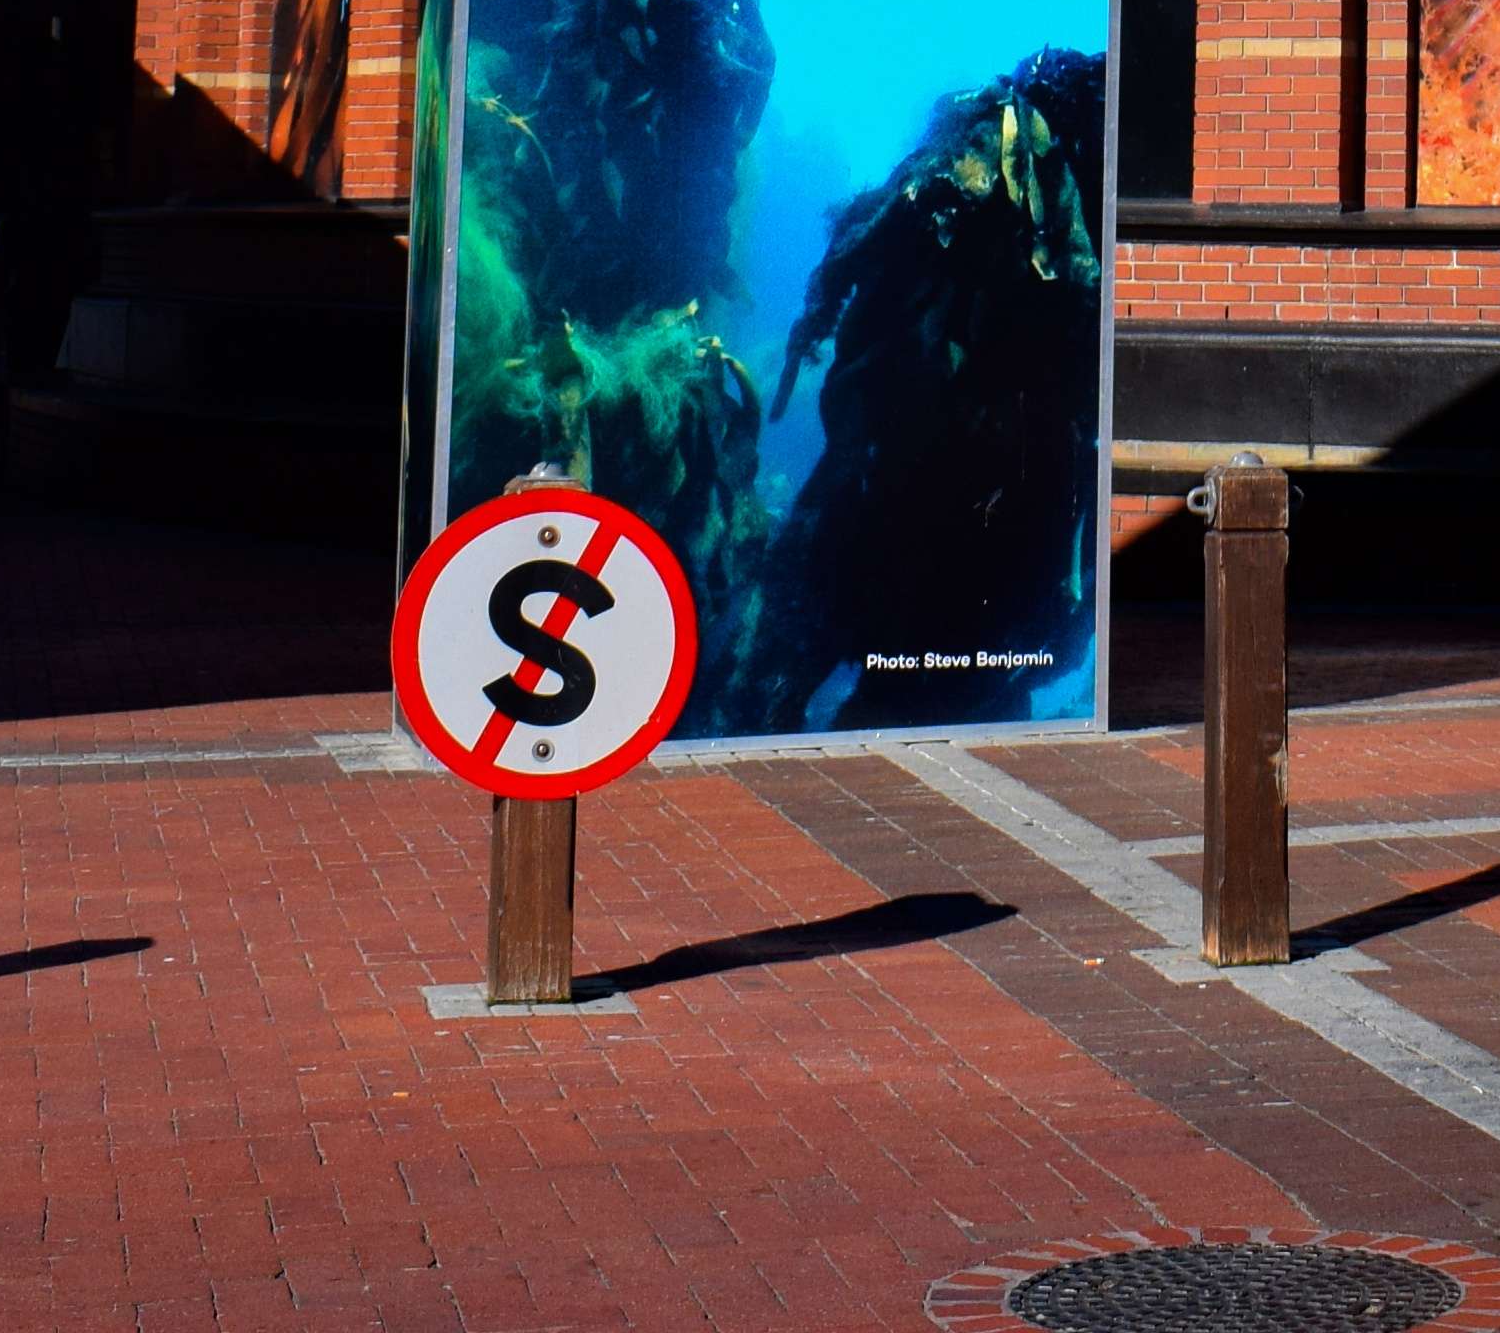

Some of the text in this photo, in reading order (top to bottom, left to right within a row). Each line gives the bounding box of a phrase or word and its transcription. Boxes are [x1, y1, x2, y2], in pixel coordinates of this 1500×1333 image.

[482, 558, 616, 727] S
[866, 649, 1054, 670] Photo: Steve Benjamin
